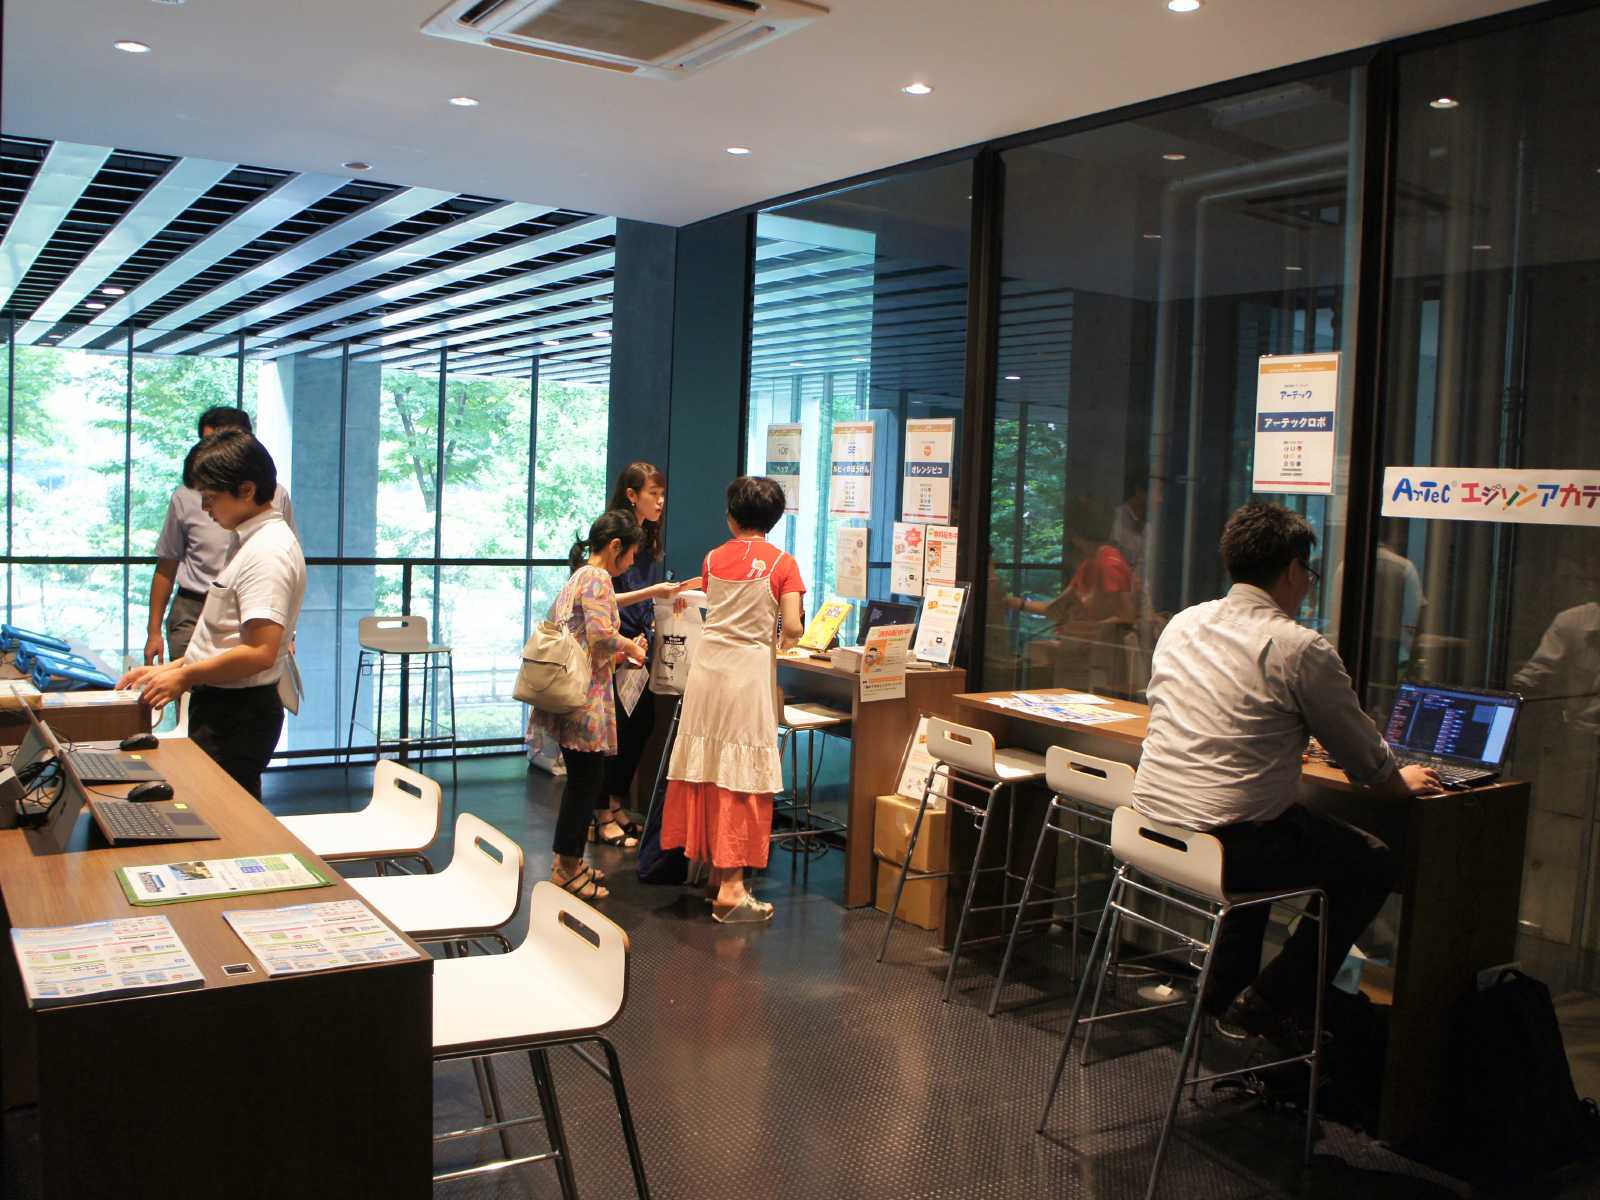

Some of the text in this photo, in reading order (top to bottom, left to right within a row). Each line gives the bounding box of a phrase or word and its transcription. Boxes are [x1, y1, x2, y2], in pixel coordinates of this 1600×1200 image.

[1280, 390, 1312, 400] アーテック
[1264, 416, 1327, 429] アーテックロボ
[878, 628, 911, 638] 無料配布中
